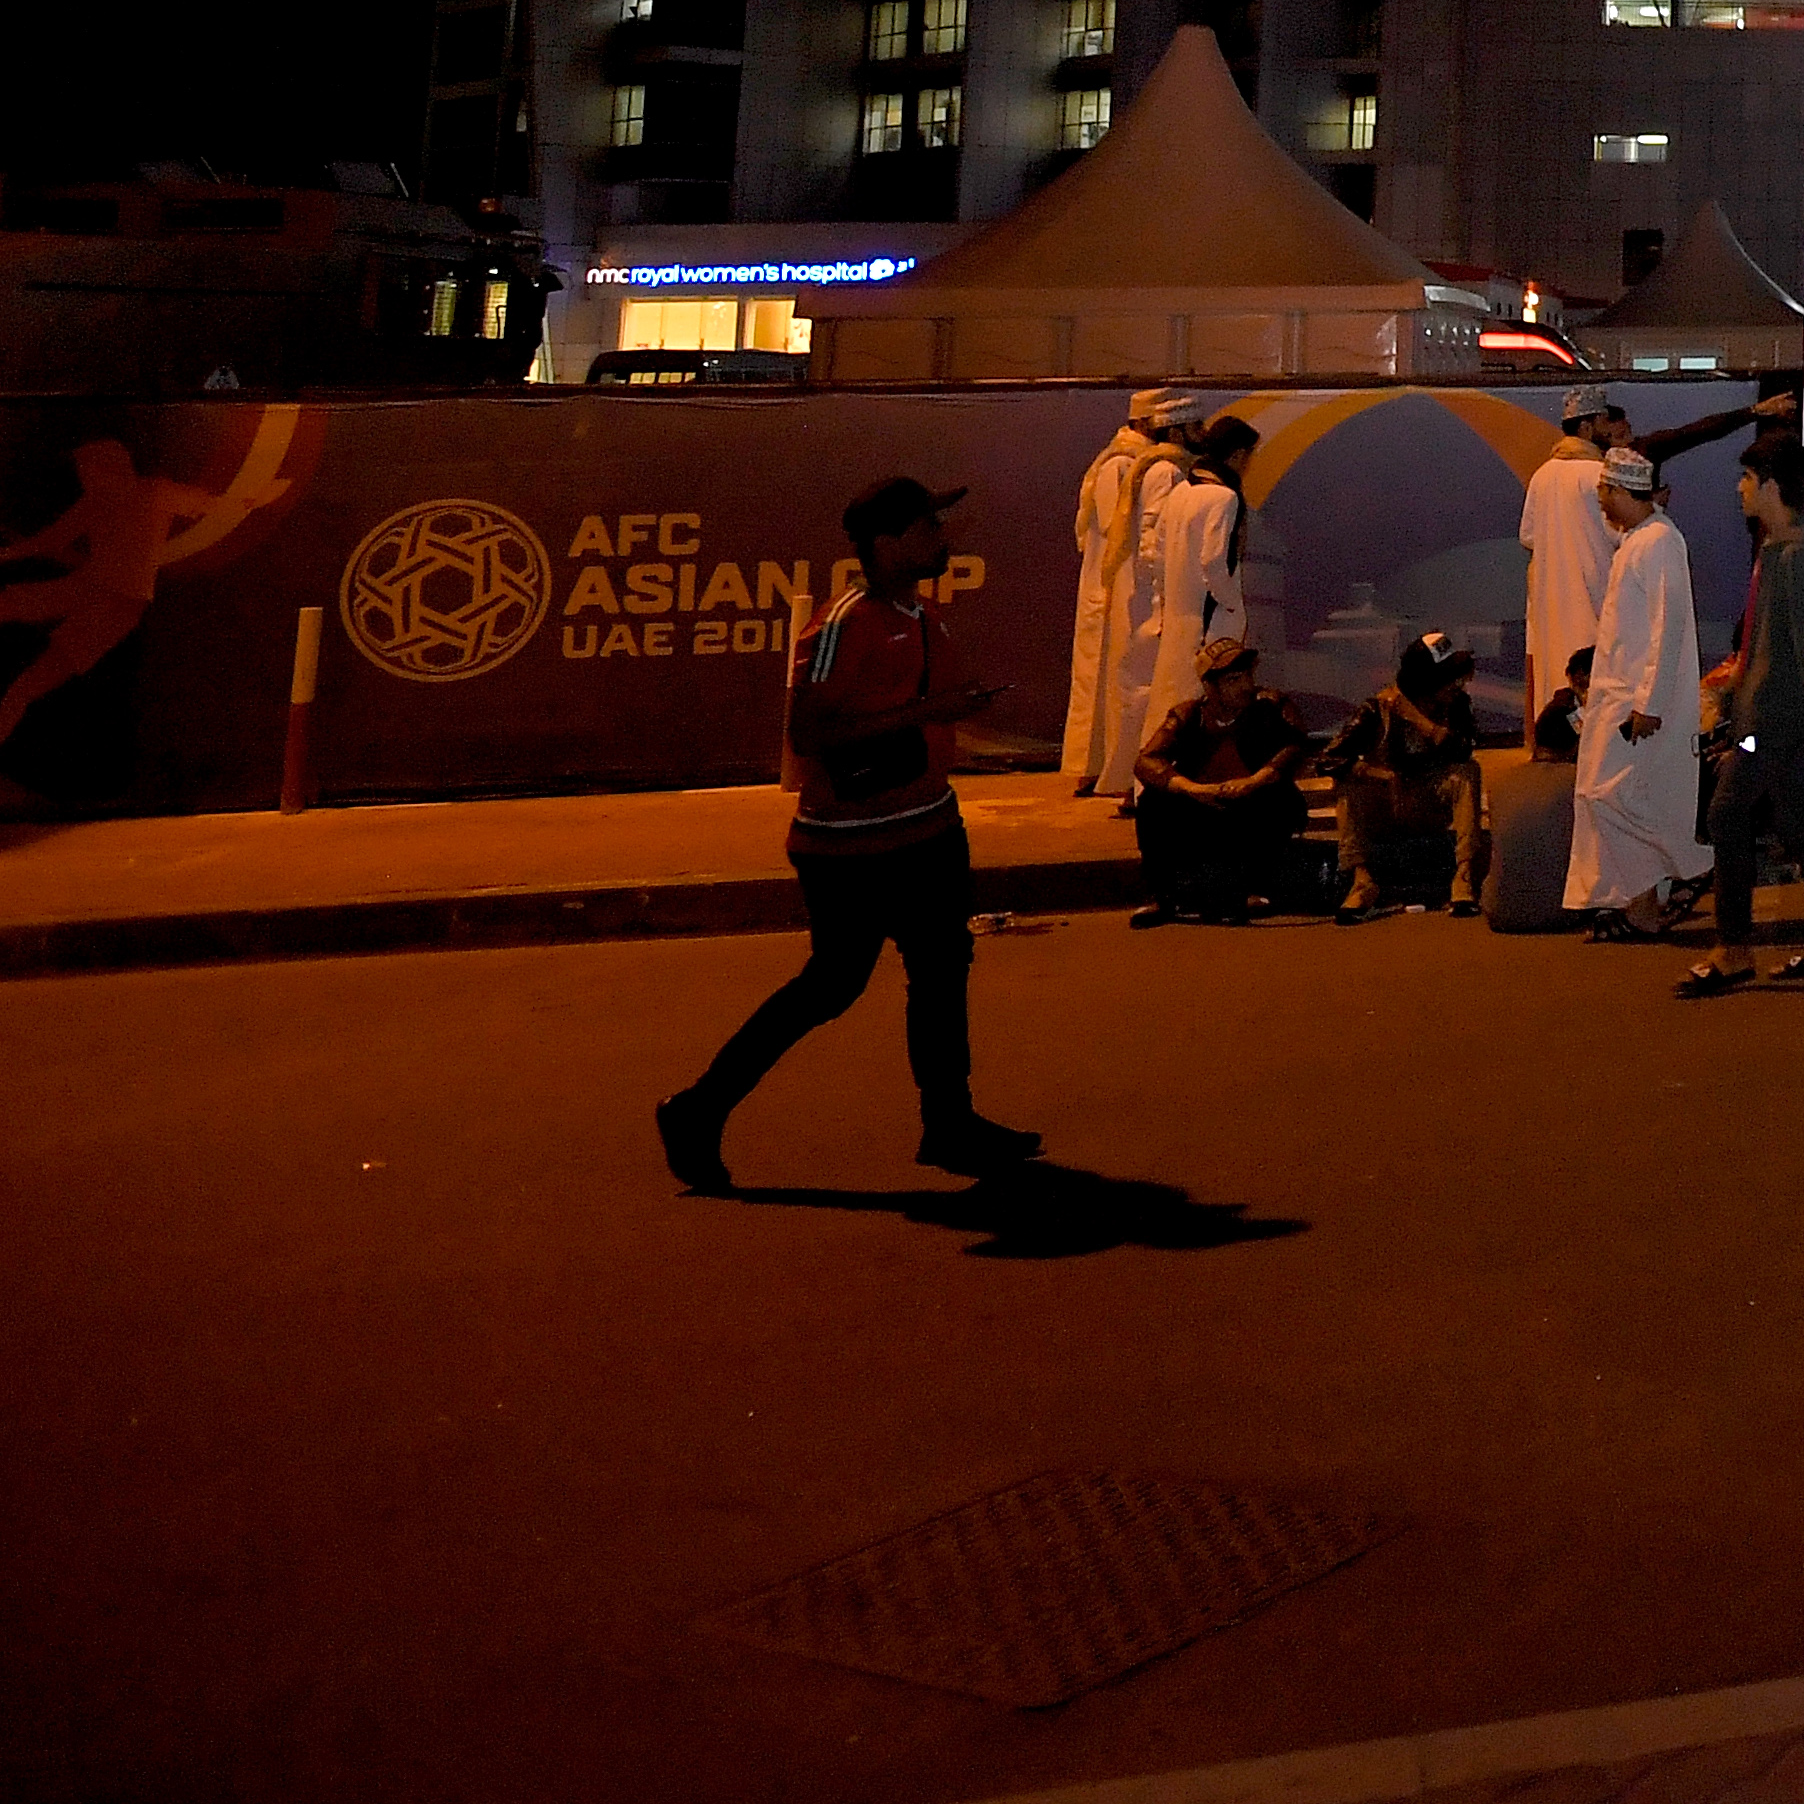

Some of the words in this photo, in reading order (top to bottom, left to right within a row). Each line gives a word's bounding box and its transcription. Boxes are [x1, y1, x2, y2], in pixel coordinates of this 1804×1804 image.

[587, 267, 630, 284] nmc
[630, 264, 680, 288] royal
[680, 262, 780, 283] women's
[781, 261, 868, 285] hospital
[567, 512, 702, 558] AFC
[562, 557, 811, 616] ASIAN
[831, 554, 986, 607] CP
[562, 619, 675, 660] UAE
[692, 618, 786, 657] 201
